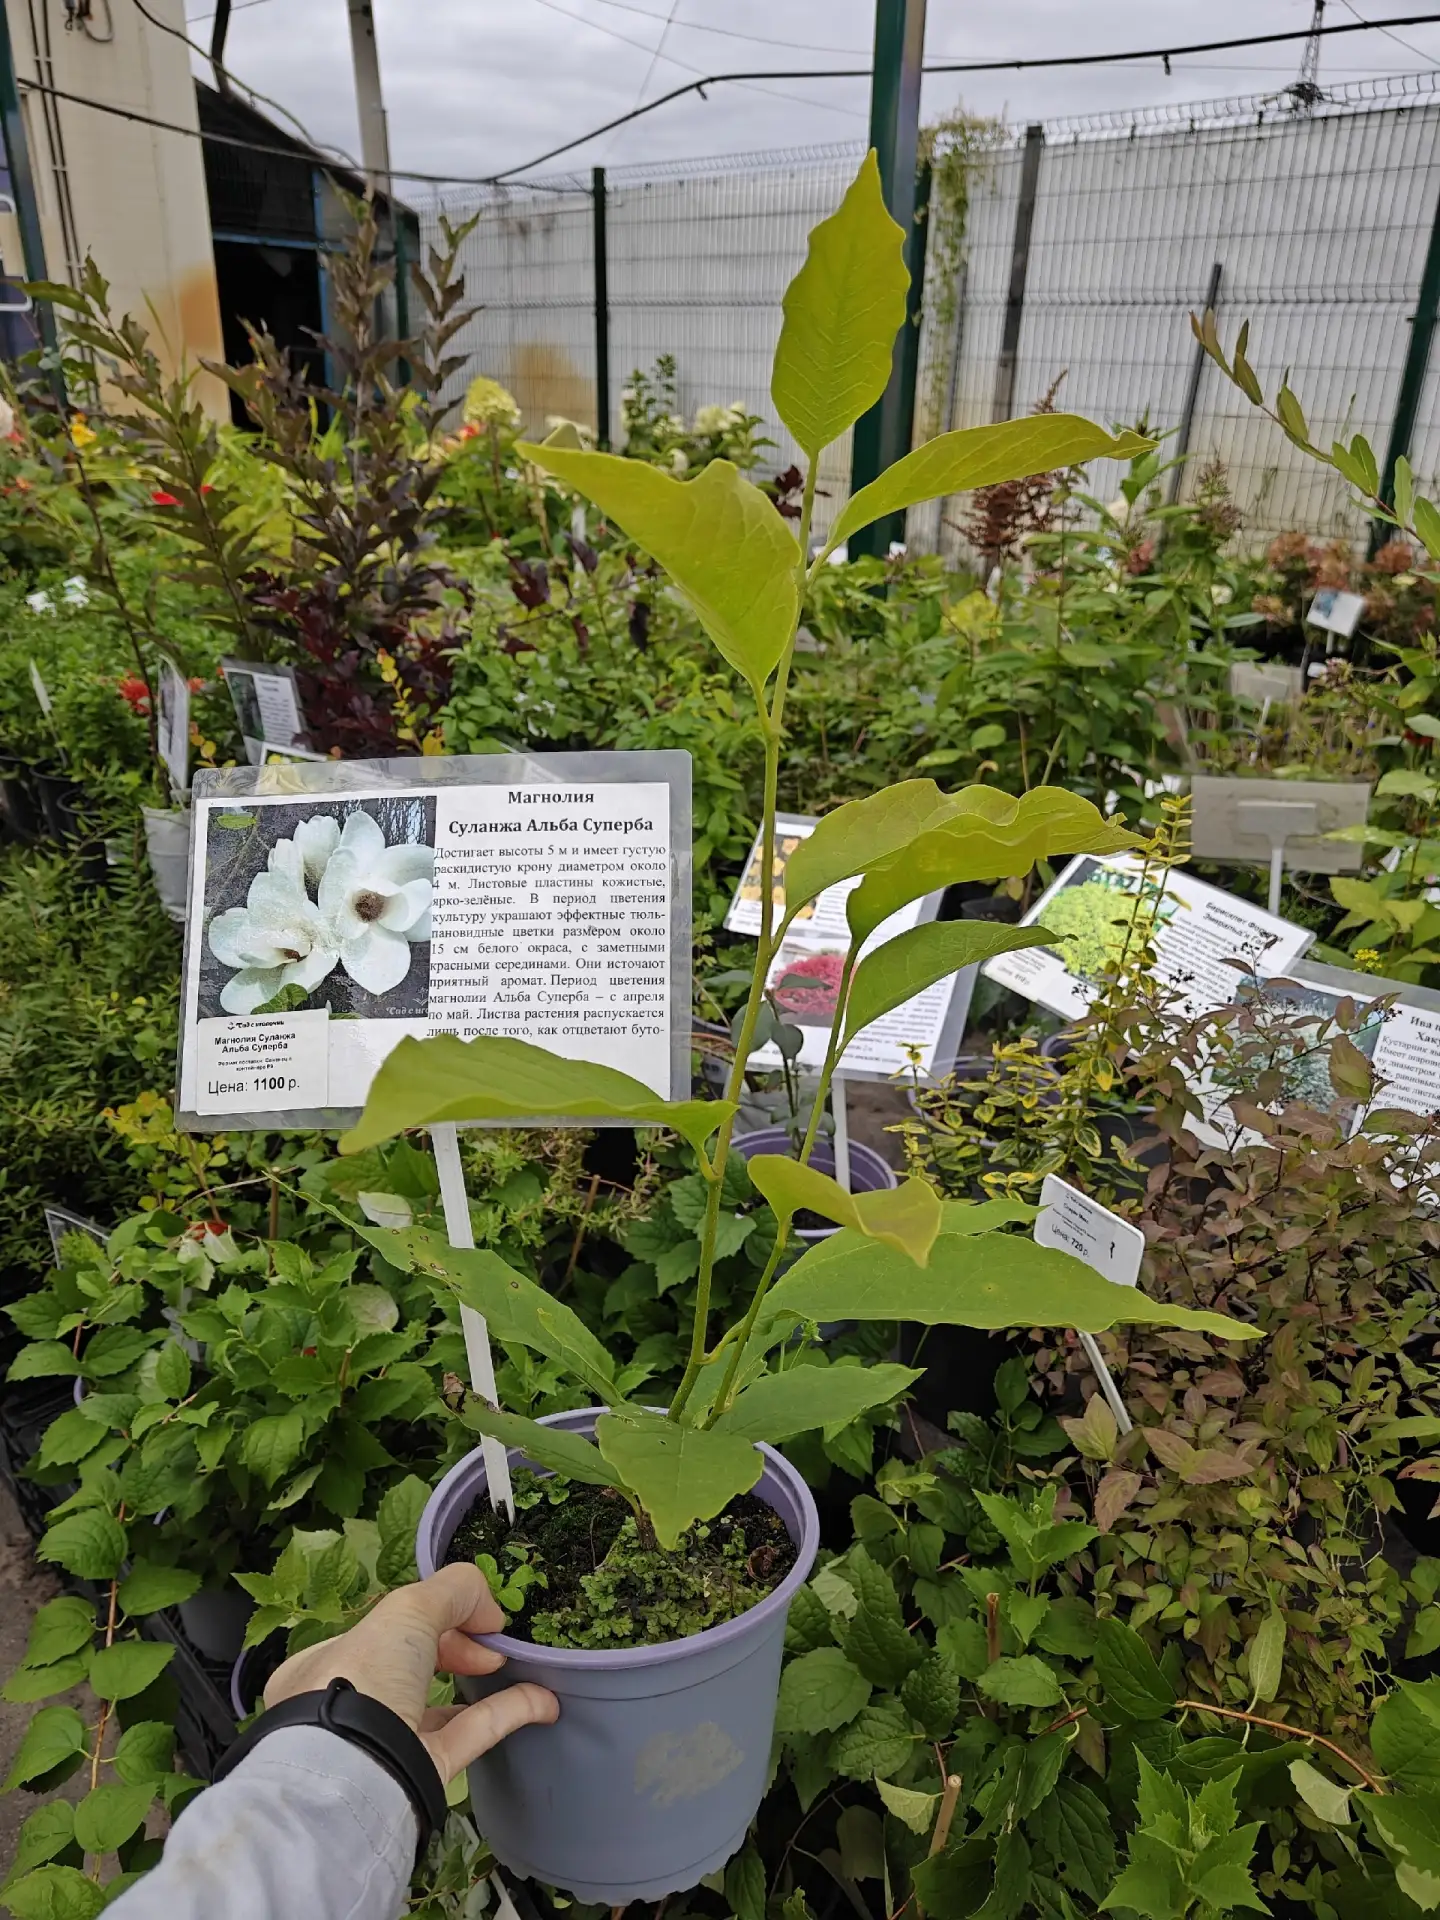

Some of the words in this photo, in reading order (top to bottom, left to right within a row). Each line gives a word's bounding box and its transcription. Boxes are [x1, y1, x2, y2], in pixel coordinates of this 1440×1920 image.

[507, 790, 595, 805] Магнолия
[448, 820, 522, 836] Суланжа
[526, 819, 578, 832] Альба
[582, 817, 653, 835] Суперба
[434, 847, 495, 860] Достигает
[498, 847, 543, 857] высоты
[547, 845, 554, 856] 5
[558, 847, 567, 855] м
[571, 847, 579, 855] и
[583, 847, 618, 855] имеет
[622, 846, 666, 857] густую
[434, 863, 512, 875] раскидистую
[517, 863, 552, 874] крону
[558, 862, 624, 873] диаметром
[630, 862, 667, 871] около
[432, 879, 440, 890] 4
[448, 881, 460, 890] м.
[467, 878, 527, 890] Листовые
[535, 879, 594, 888] пластины
[602, 878, 666, 889] кожистые,
[432, 895, 516, 907] ярко-зелёные.
[530, 893, 539, 904] В
[553, 895, 596, 906] период
[610, 894, 666, 904] цветения
[432, 912, 486, 924] культуру
[491, 911, 552, 922] украшают
[556, 909, 625, 922] эффектные
[630, 911, 666, 921] тюль-
[431, 928, 504, 939] пановидные
[512, 928, 554, 938] цветки
[562, 927, 621, 939] размером
[630, 927, 666, 936] около
[431, 943, 444, 955] 15
[453, 945, 469, 954] см
[477, 942, 519, 954] белого
[528, 944, 572, 956] окраса,
[581, 944, 588, 953] с
[596, 943, 665, 953] заметными
[430, 961, 490, 972] красными
[495, 960, 570, 972] серединами.
[575, 958, 601, 970] Они
[607, 960, 665, 970] источают
[429, 976, 489, 988] приятный
[500, 977, 547, 988] аромат.
[550, 975, 597, 988] Период
[609, 976, 665, 988] цветения
[428, 993, 487, 1003] магнолии
[493, 991, 531, 1003] Альба
[537, 991, 589, 1005] Суперба
[609, 993, 616, 1002] с
[623, 992, 665, 1003] апреля
[428, 1009, 443, 1020] по
[446, 1008, 473, 1020] май.
[476, 1007, 520, 1020] Листва
[524, 1008, 579, 1021] растения
[583, 1008, 664, 1021] распускается
[463, 1026, 499, 1036] после
[504, 1026, 533, 1037] того,
[537, 1025, 557, 1035] как
[562, 1025, 627, 1037] отцветают
[631, 1023, 665, 1037] буто-
[215, 1036, 256, 1046] Магнолия
[258, 1033, 296, 1043] Суланжа
[251, 1041, 288, 1052] Суперба
[208, 1080, 248, 1097] Цена:
[253, 1076, 285, 1091] 1100
[288, 1077, 300, 1091] р.
[1071, 1237, 1083, 1252] 720
